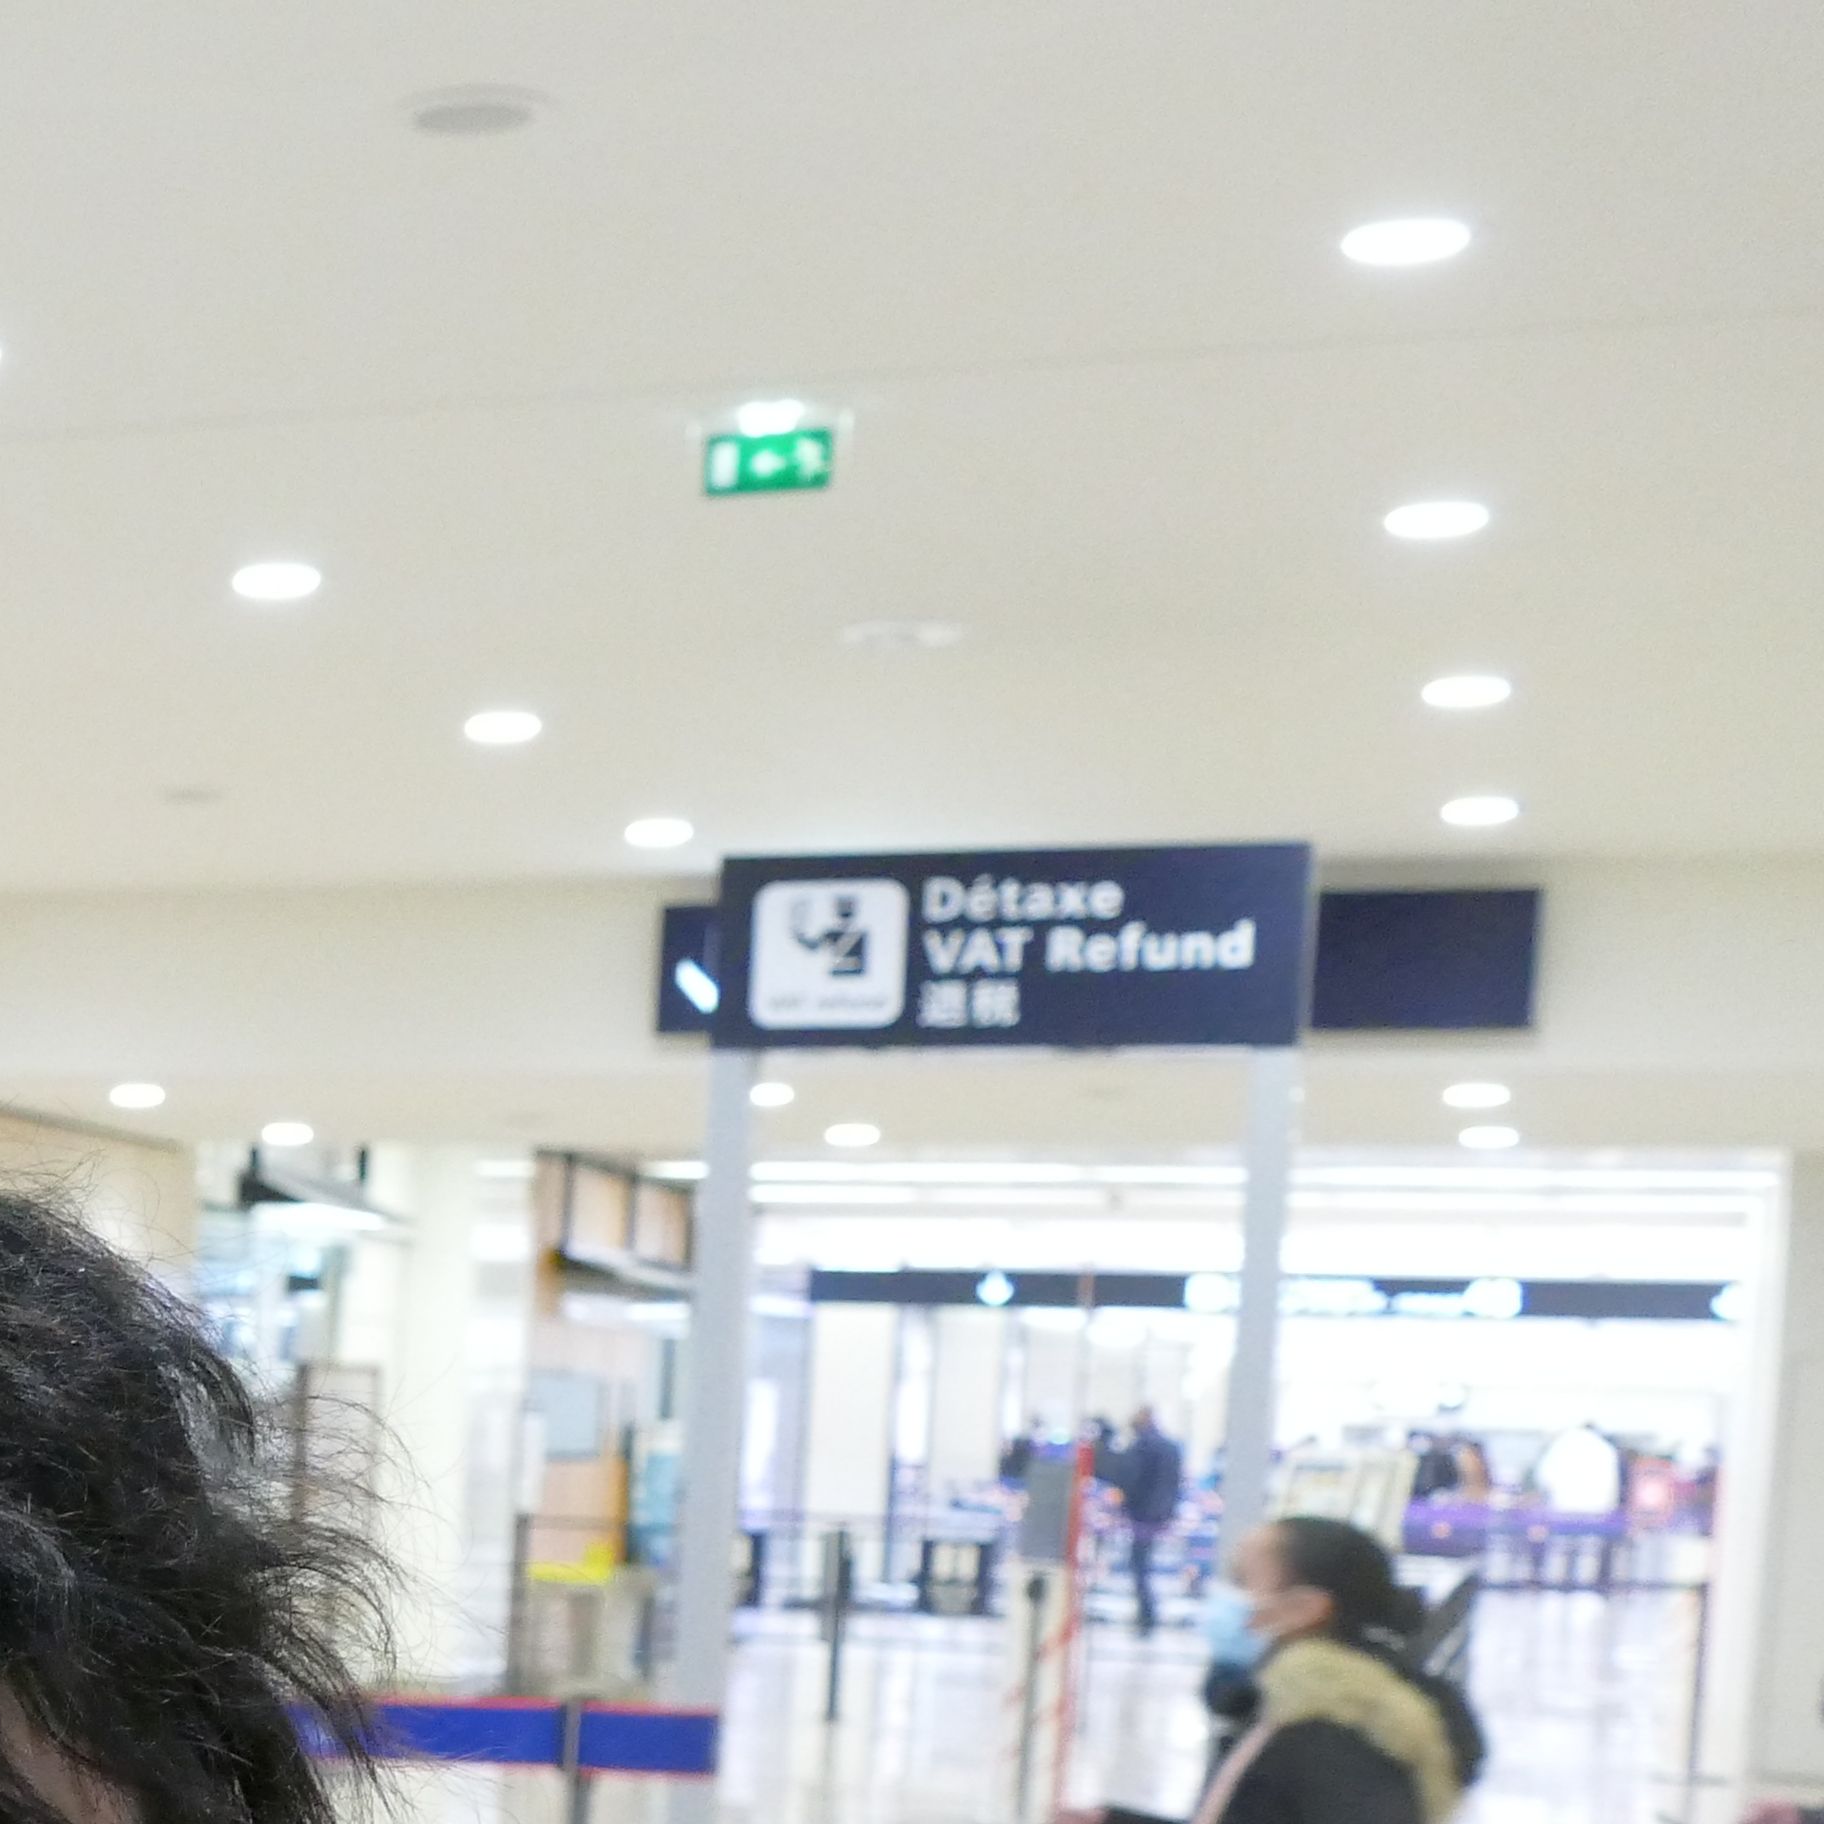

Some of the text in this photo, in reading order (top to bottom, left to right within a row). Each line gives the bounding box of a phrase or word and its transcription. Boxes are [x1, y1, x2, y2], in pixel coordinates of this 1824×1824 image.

[922, 873, 1125, 923] Détaxe
[922, 917, 1257, 974] VAT Refund
